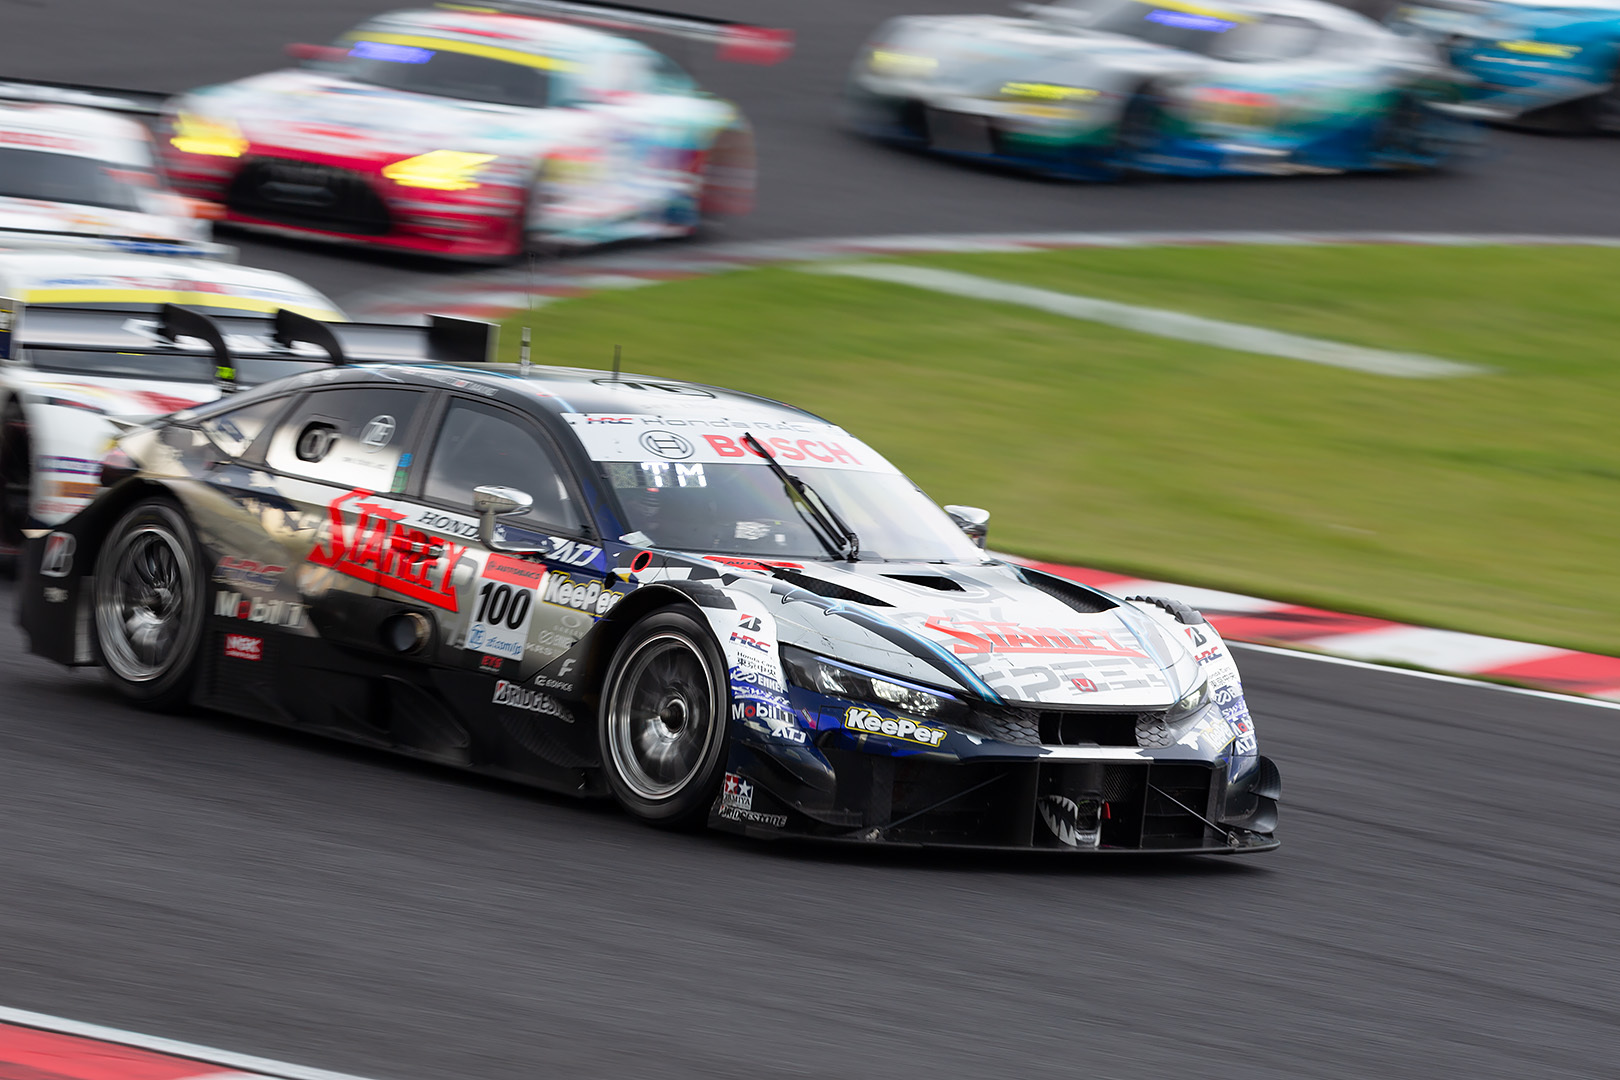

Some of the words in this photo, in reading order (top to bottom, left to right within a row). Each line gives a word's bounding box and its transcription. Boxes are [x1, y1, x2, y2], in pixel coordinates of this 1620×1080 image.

[703, 434, 863, 465] BOSCH
[641, 462, 707, 488] TM
[304, 487, 469, 613] STANLEY
[476, 581, 532, 630] 100
[545, 571, 622, 614] KeePer
[729, 631, 771, 654] HRC
[924, 616, 1150, 659] STANLEY
[1194, 645, 1223, 667] HRC
[731, 702, 778, 720] Mobil
[847, 708, 944, 745] KeePer
